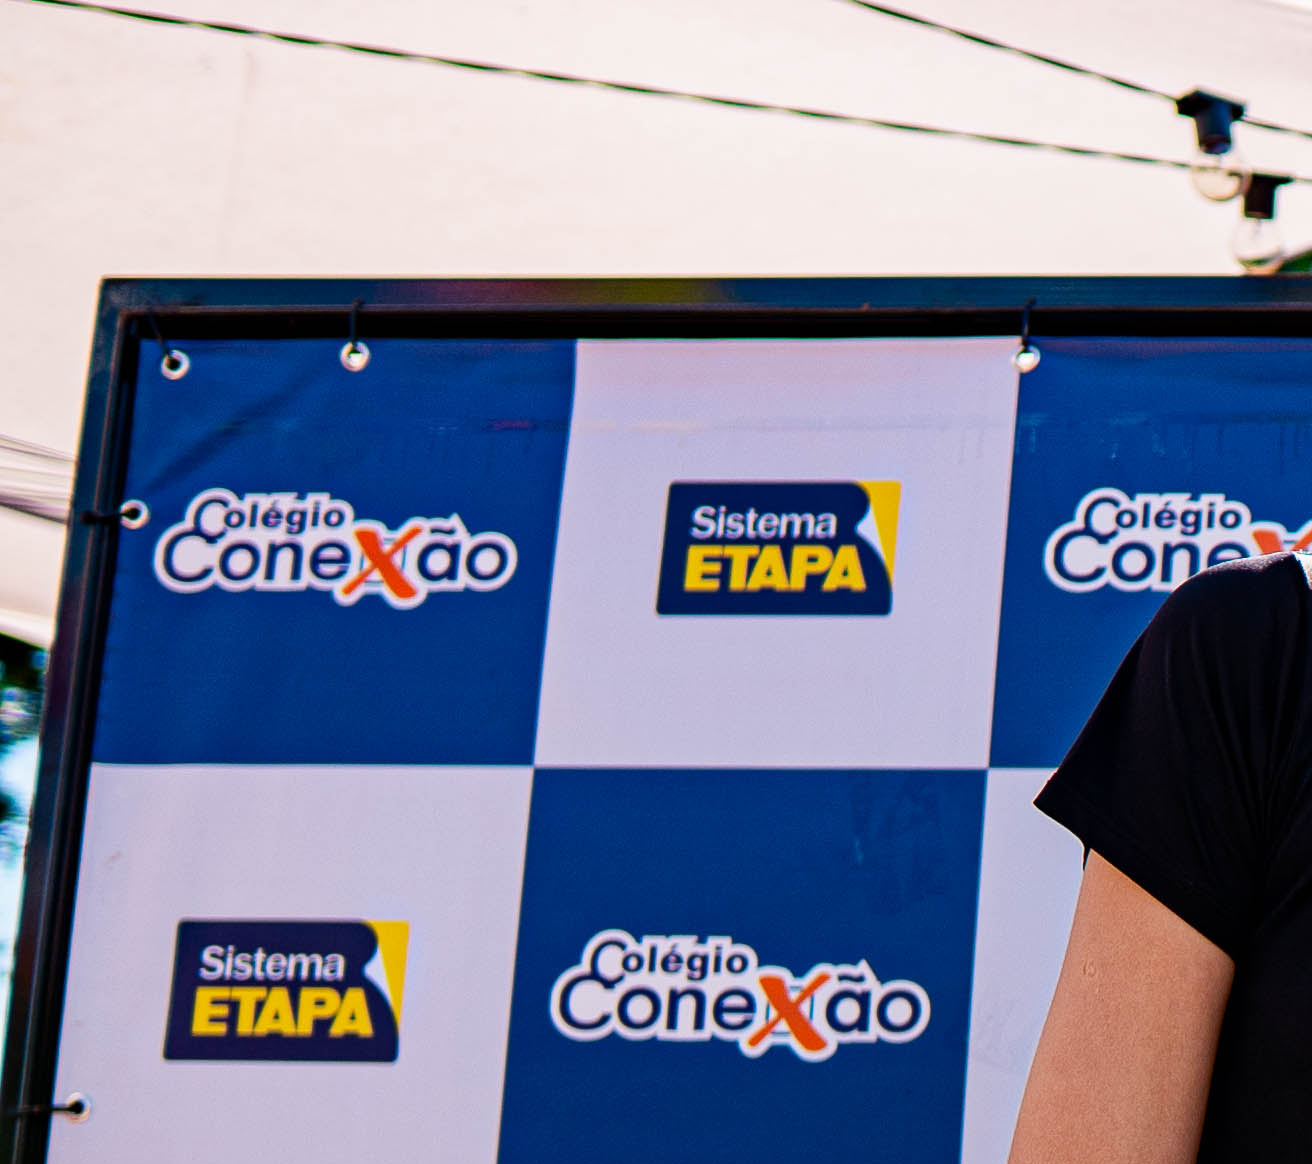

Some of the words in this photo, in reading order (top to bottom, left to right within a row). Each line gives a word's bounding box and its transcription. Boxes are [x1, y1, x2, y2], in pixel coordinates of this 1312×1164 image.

[191, 496, 346, 537] Colégio
[692, 506, 837, 538] Sistema
[1084, 496, 1242, 537] Colégio
[684, 545, 865, 591] ETAPA
[200, 945, 345, 981] Sistema
[591, 938, 750, 984] Colégio
[191, 986, 373, 1037] ETAPA
